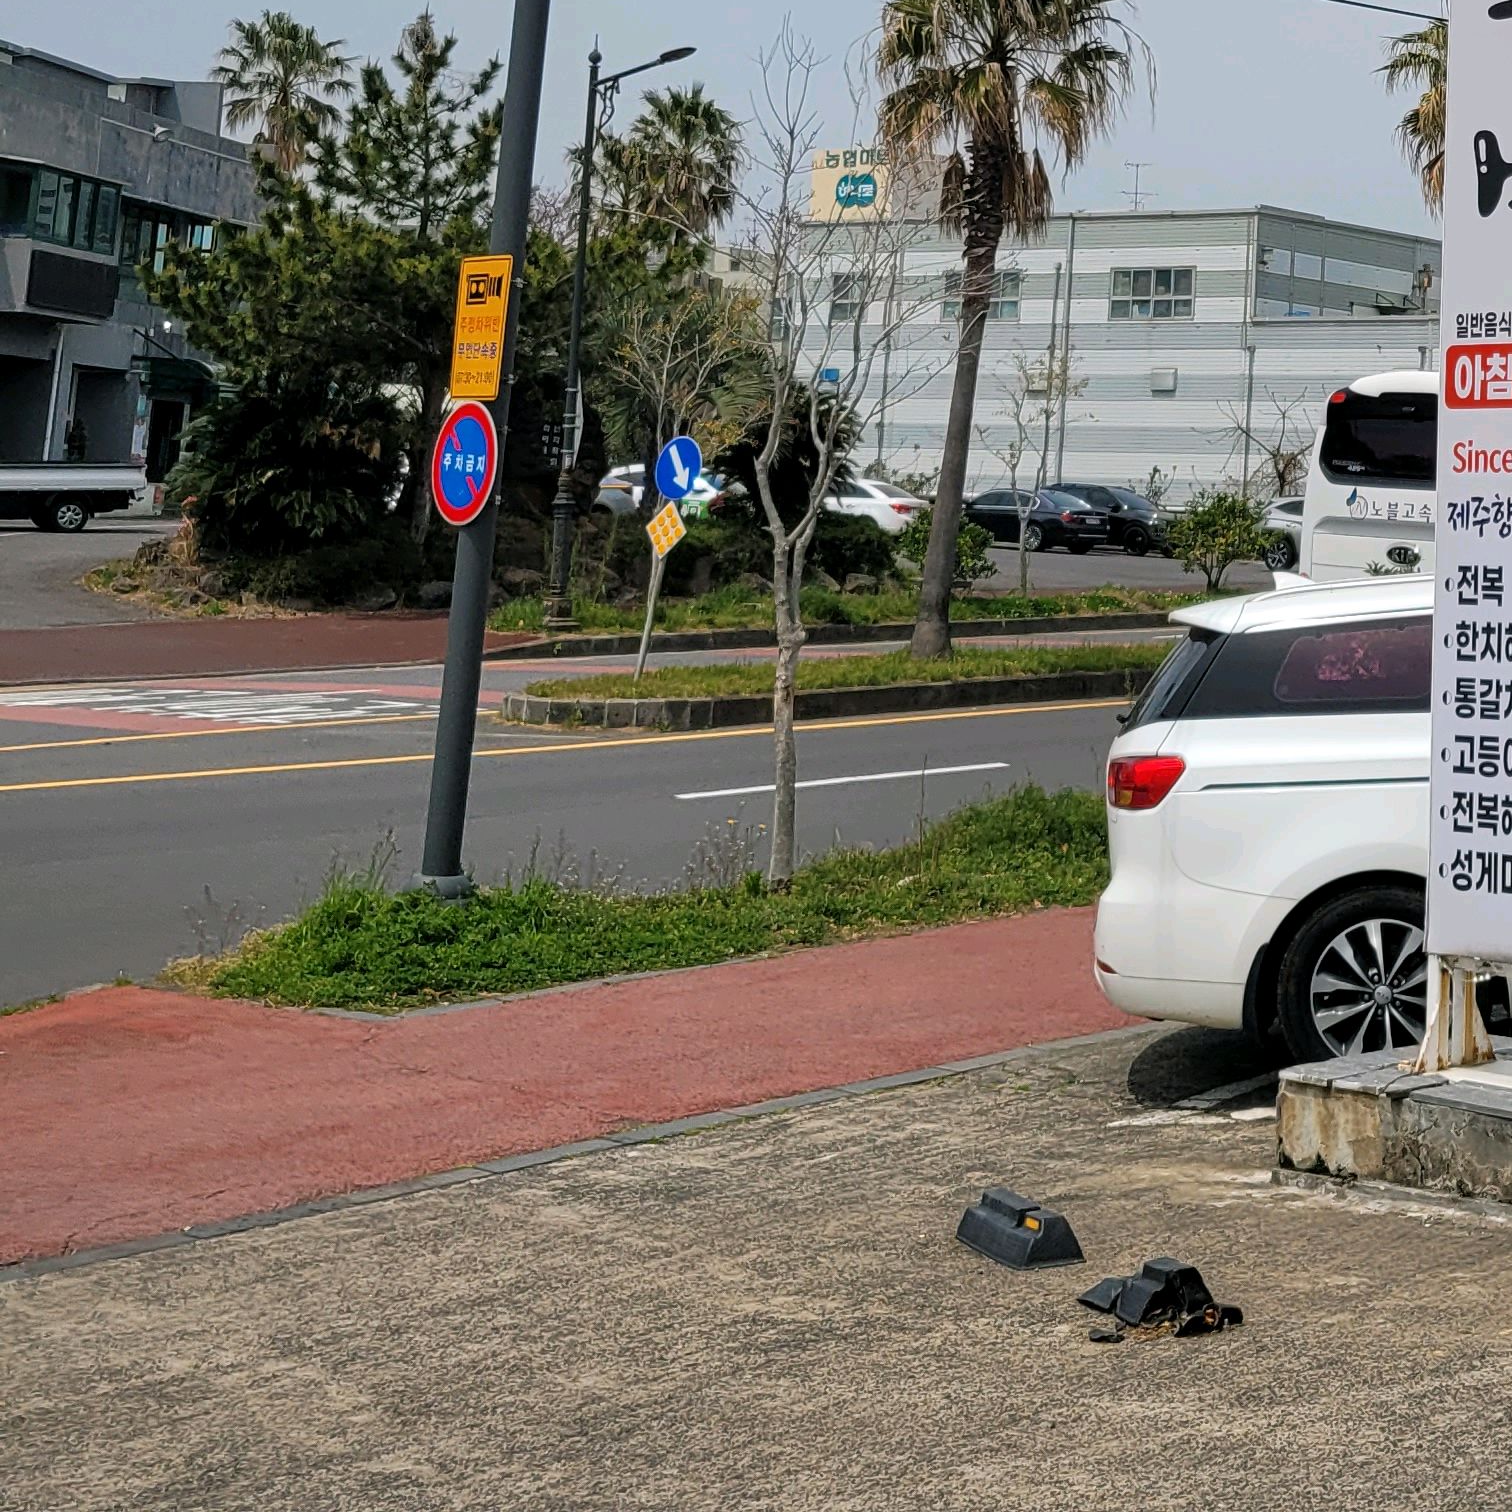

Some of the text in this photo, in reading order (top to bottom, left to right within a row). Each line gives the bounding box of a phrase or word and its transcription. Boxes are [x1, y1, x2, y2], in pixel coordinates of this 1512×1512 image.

[443, 453, 486, 473] 주차금지
[1370, 501, 1433, 524] 노블고속
[1456, 565, 1504, 607] 전복
